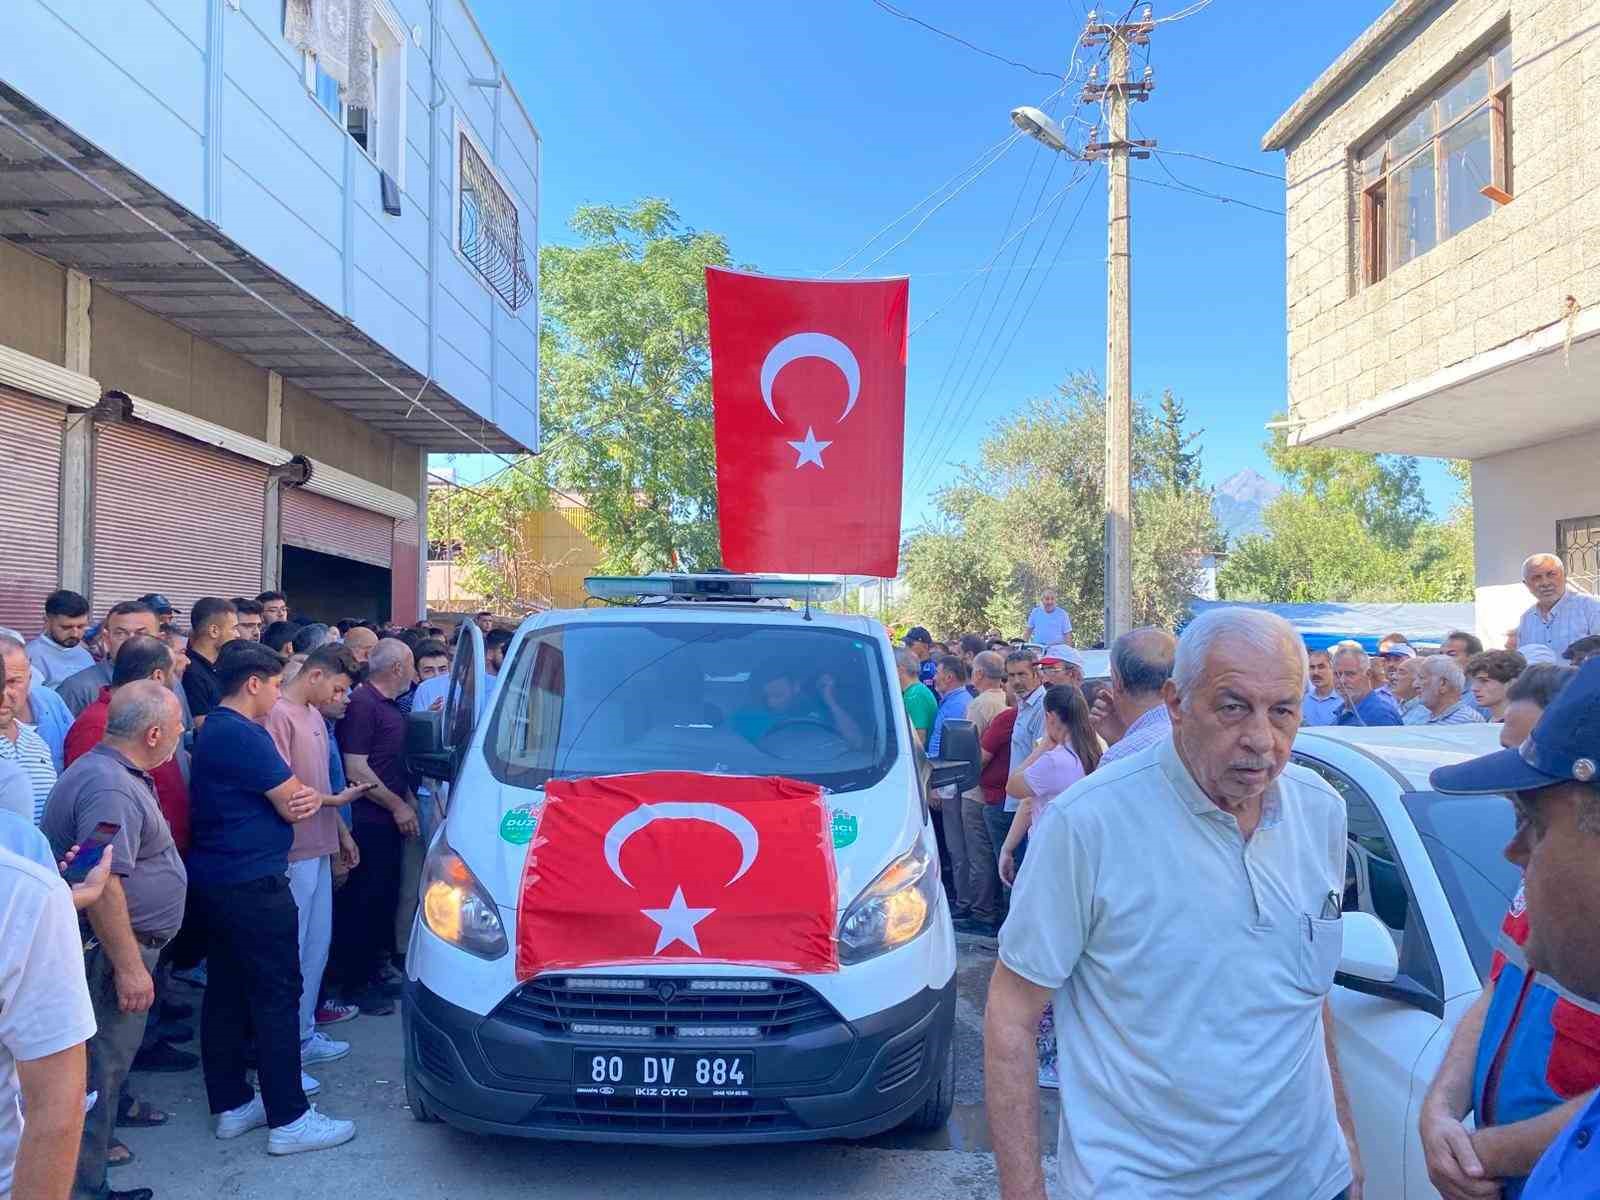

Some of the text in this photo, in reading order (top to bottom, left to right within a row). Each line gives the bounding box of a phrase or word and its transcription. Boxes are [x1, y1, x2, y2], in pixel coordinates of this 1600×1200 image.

[592, 1055, 744, 1085] 80 DV 884
[660, 1088, 688, 1097] OTO
